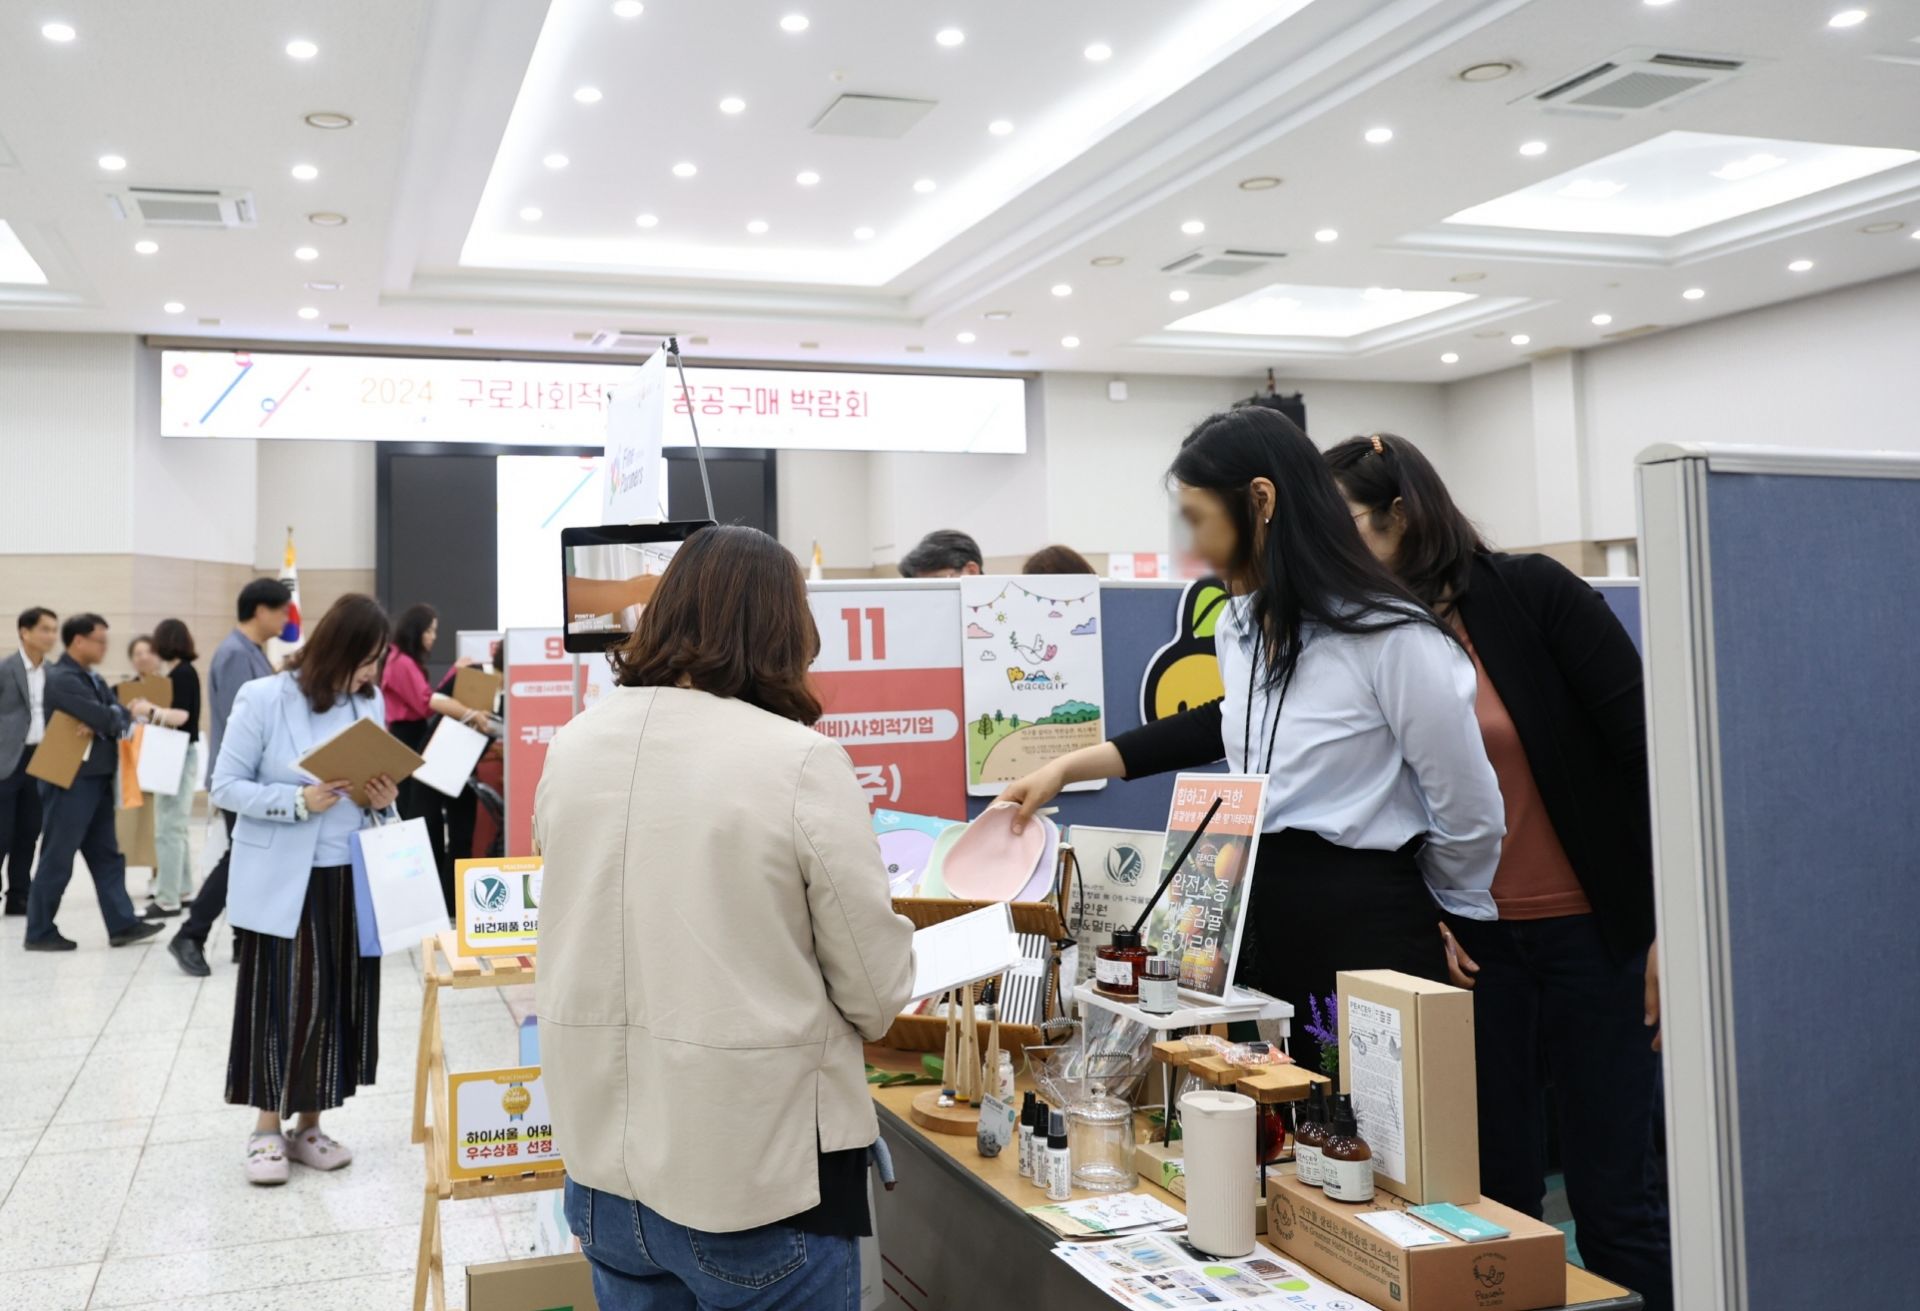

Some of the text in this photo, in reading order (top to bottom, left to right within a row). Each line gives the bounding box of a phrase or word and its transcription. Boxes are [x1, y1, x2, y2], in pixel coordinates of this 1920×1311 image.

[361, 377, 868, 418] 2024 구로사회적 공공구매 박람회
[841, 607, 886, 661] 11
[545, 636, 564, 659] 9
[812, 716, 934, 739] 예비)사회적기업
[474, 921, 520, 934] 비건제품
[466, 1123, 552, 1144] 하이서울 어워
[466, 1139, 552, 1160] 우수상품 선정
